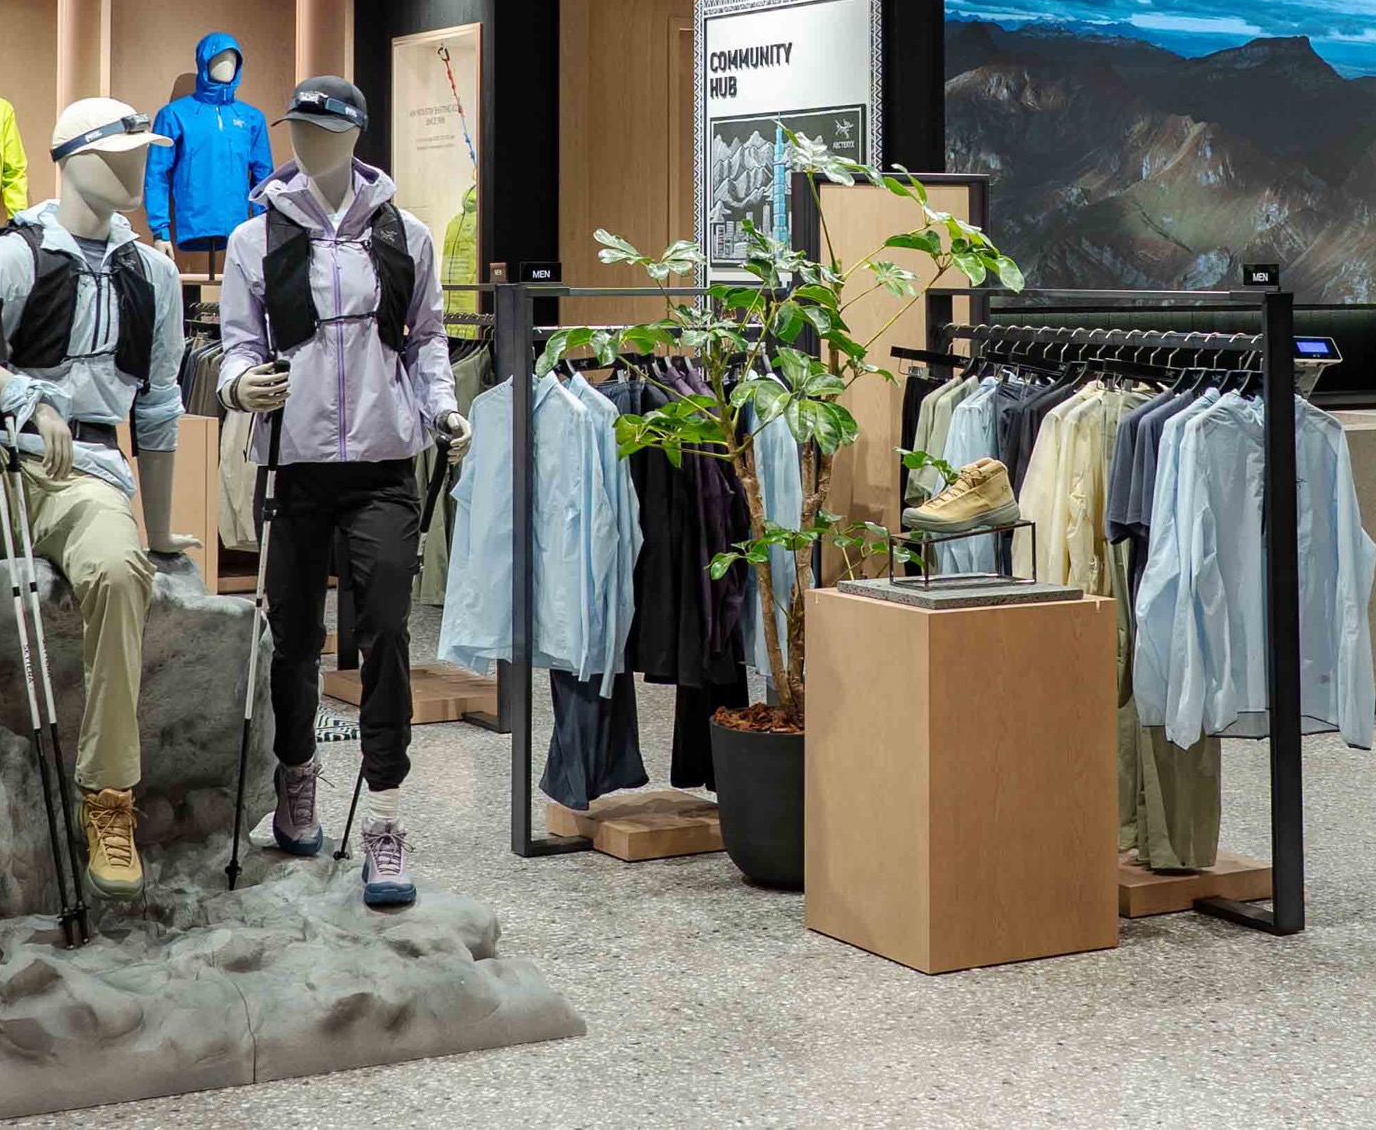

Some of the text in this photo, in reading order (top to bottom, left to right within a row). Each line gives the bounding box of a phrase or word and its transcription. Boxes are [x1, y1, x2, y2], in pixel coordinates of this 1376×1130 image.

[710, 42, 793, 74] COMMUNITY
[710, 76, 738, 99] HUB
[532, 269, 551, 279] MEN
[1252, 272, 1269, 282] MEN
